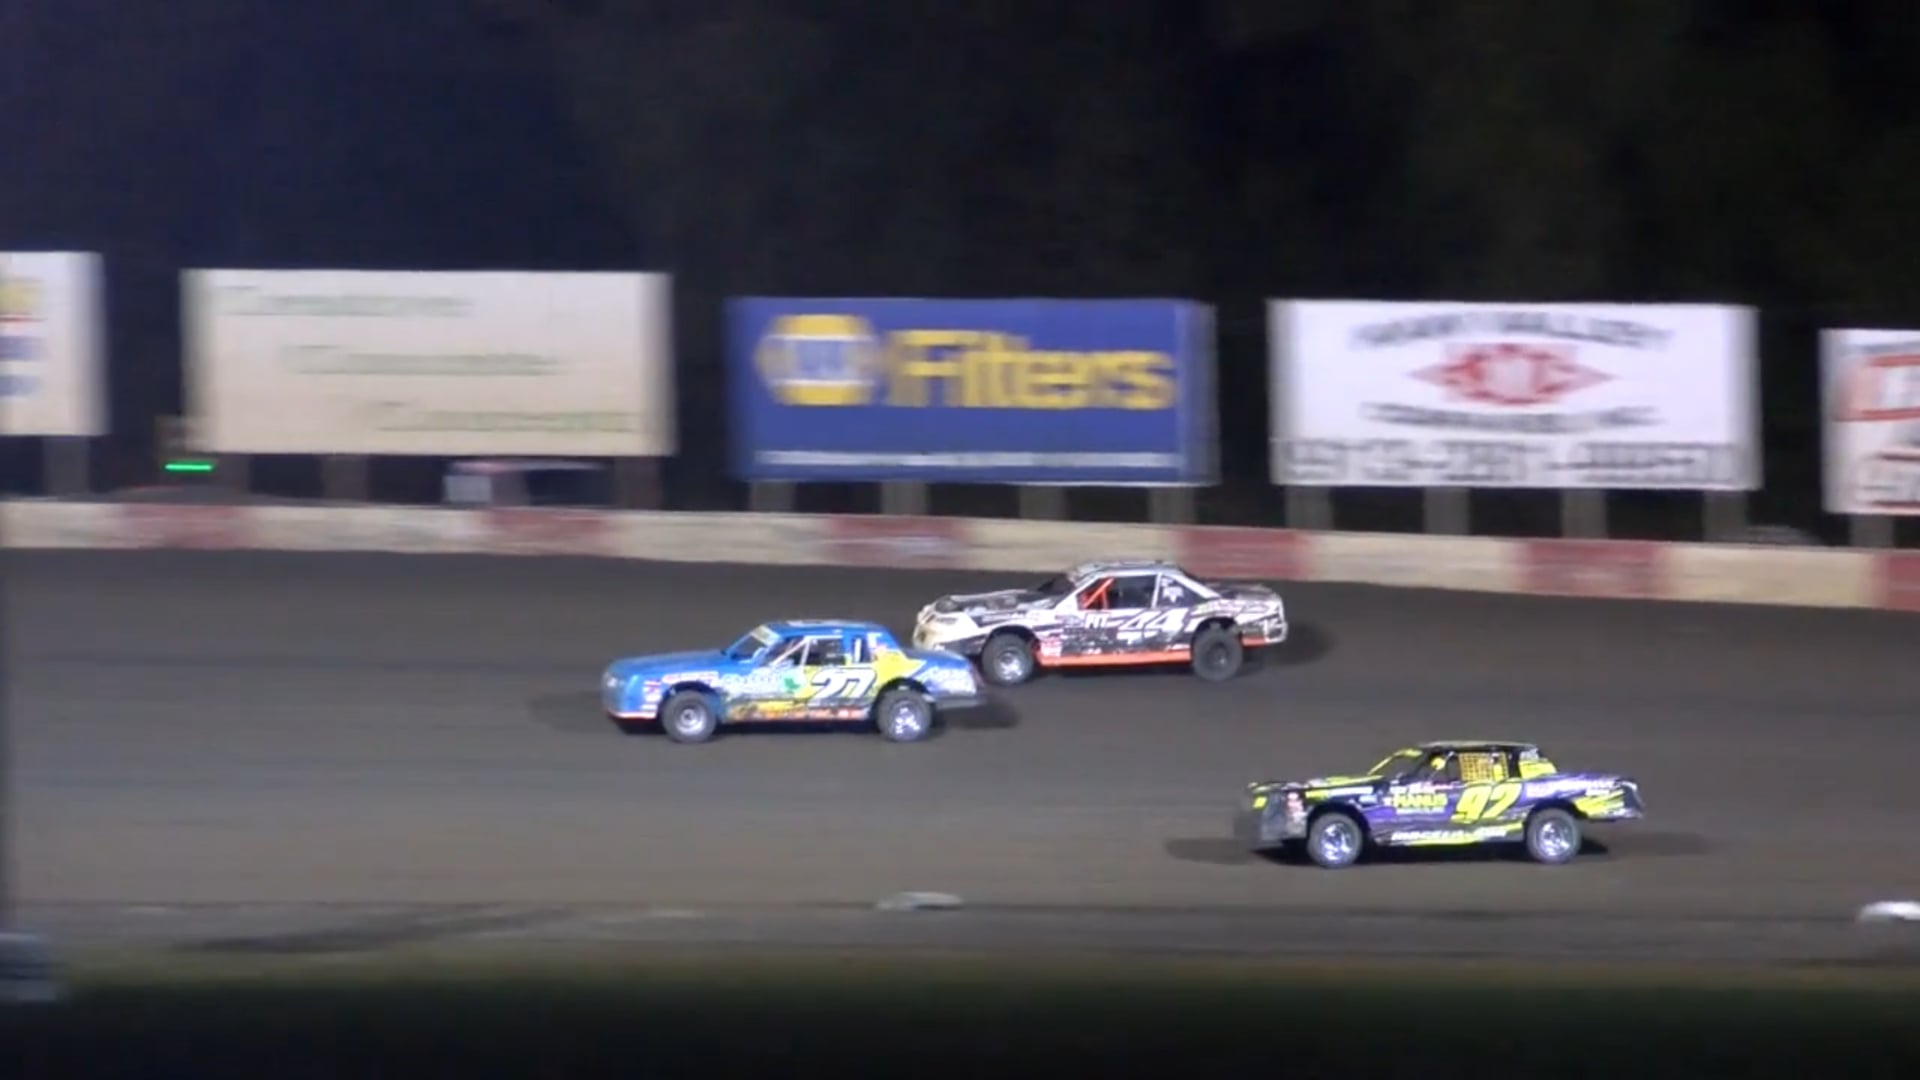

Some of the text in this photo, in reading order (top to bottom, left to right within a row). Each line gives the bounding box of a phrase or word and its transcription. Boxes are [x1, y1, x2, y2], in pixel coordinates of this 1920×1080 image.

[887, 329, 1176, 409] Filters
[1117, 606, 1189, 644] 44
[809, 667, 877, 706] 27
[1450, 780, 1523, 823] 92
